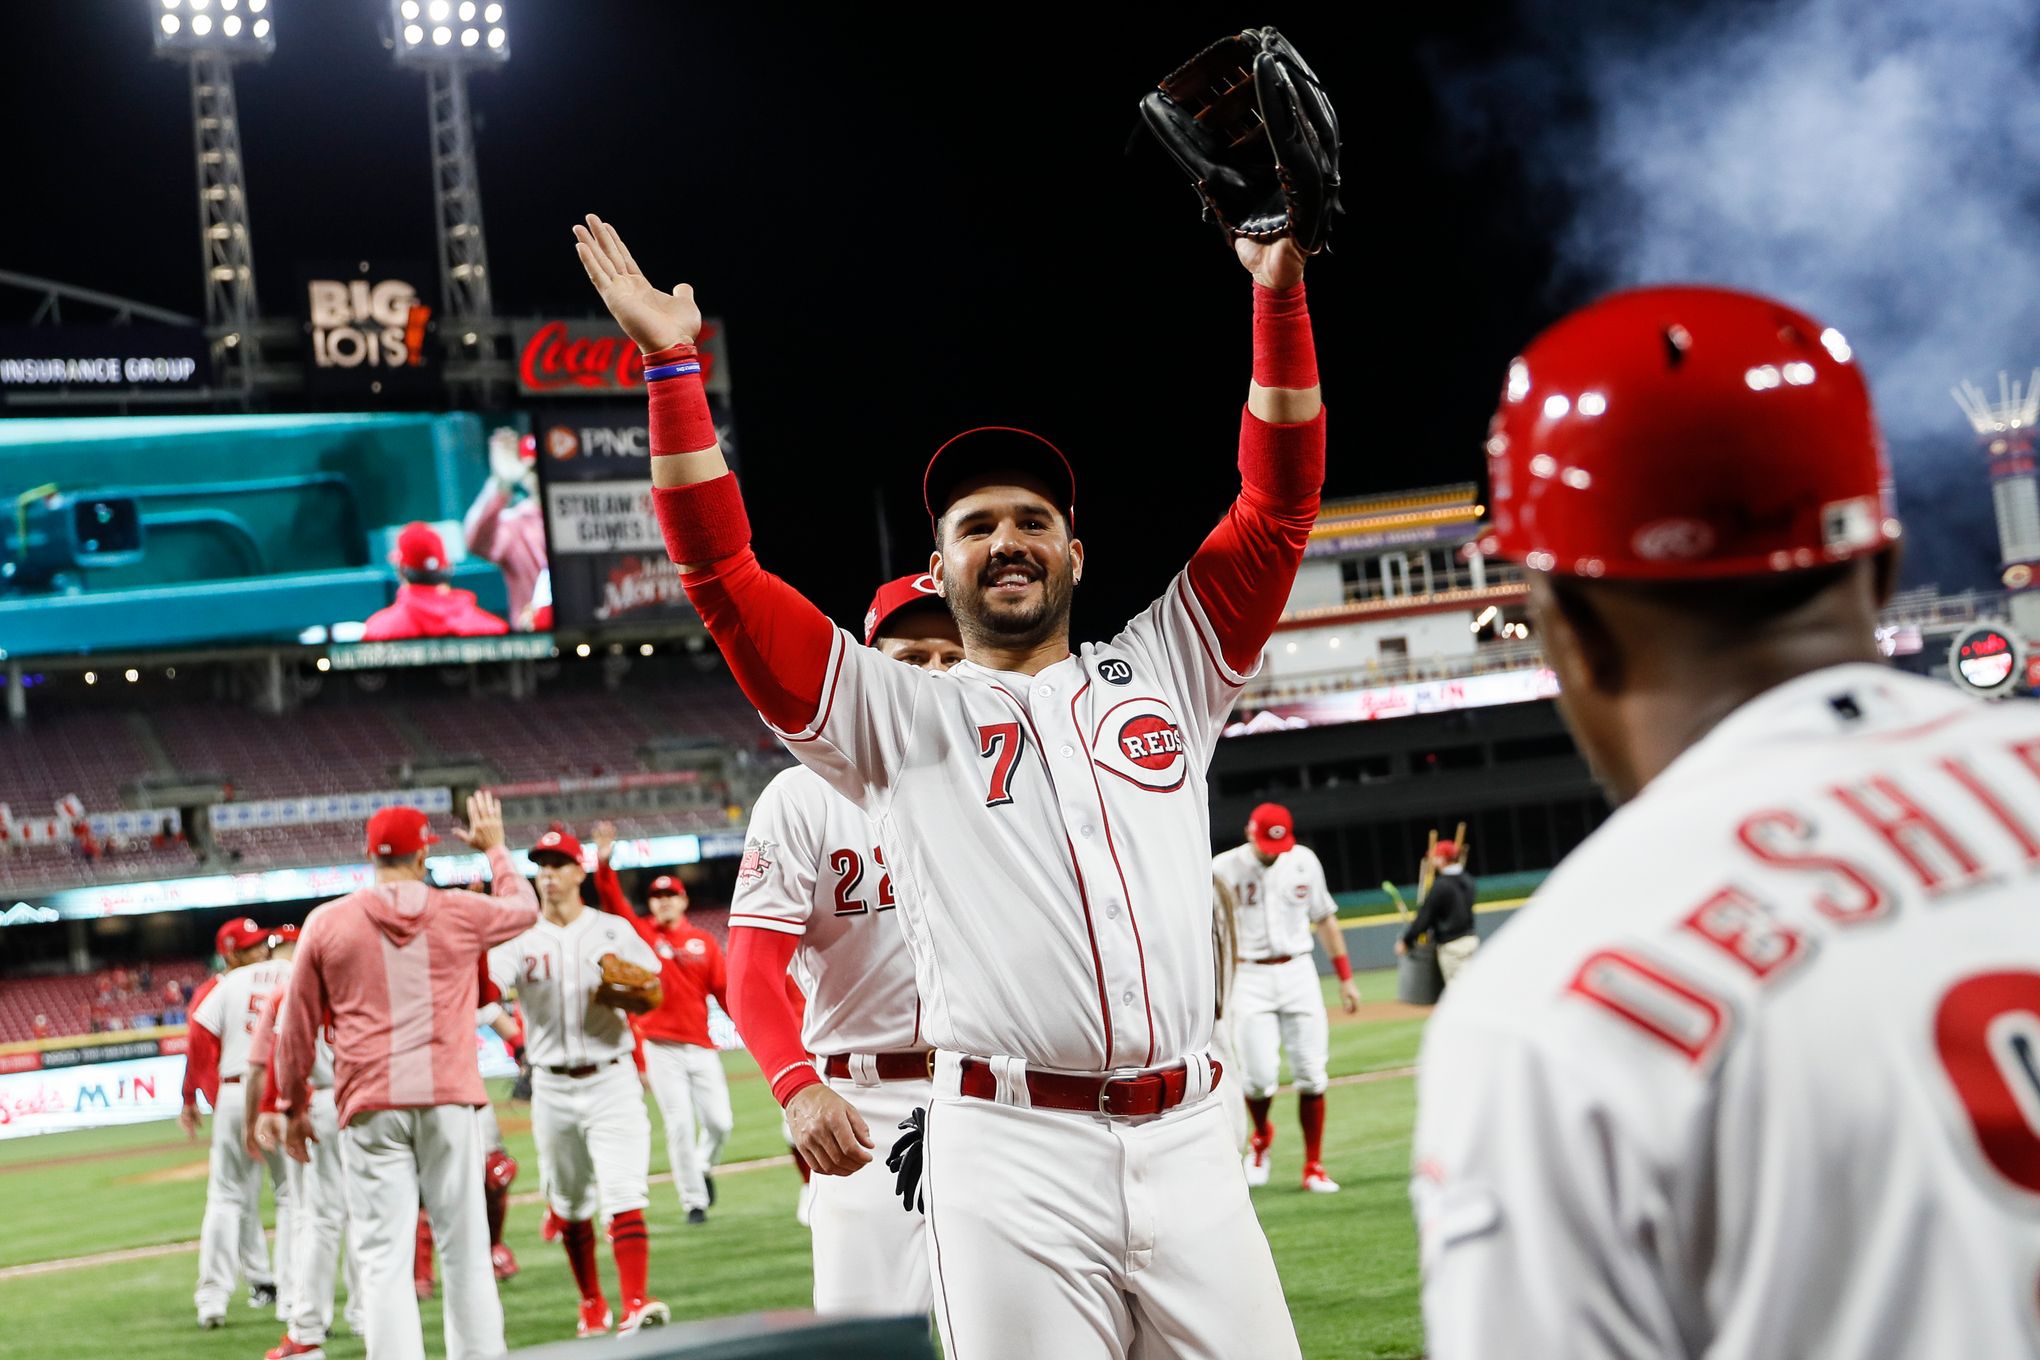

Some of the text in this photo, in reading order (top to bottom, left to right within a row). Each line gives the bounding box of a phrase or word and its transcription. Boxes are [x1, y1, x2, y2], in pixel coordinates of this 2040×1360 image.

[308, 279, 420, 327] BIG
[0, 357, 195, 383] INSURANCE GROUP
[580, 426, 648, 458] PNC
[576, 519, 641, 542] GAMES
[1101, 661, 1130, 681] 20
[1121, 724, 1184, 760] REDS
[974, 721, 1025, 808] 7
[1563, 740, 2040, 1072] DESHI
[524, 953, 551, 983] 21
